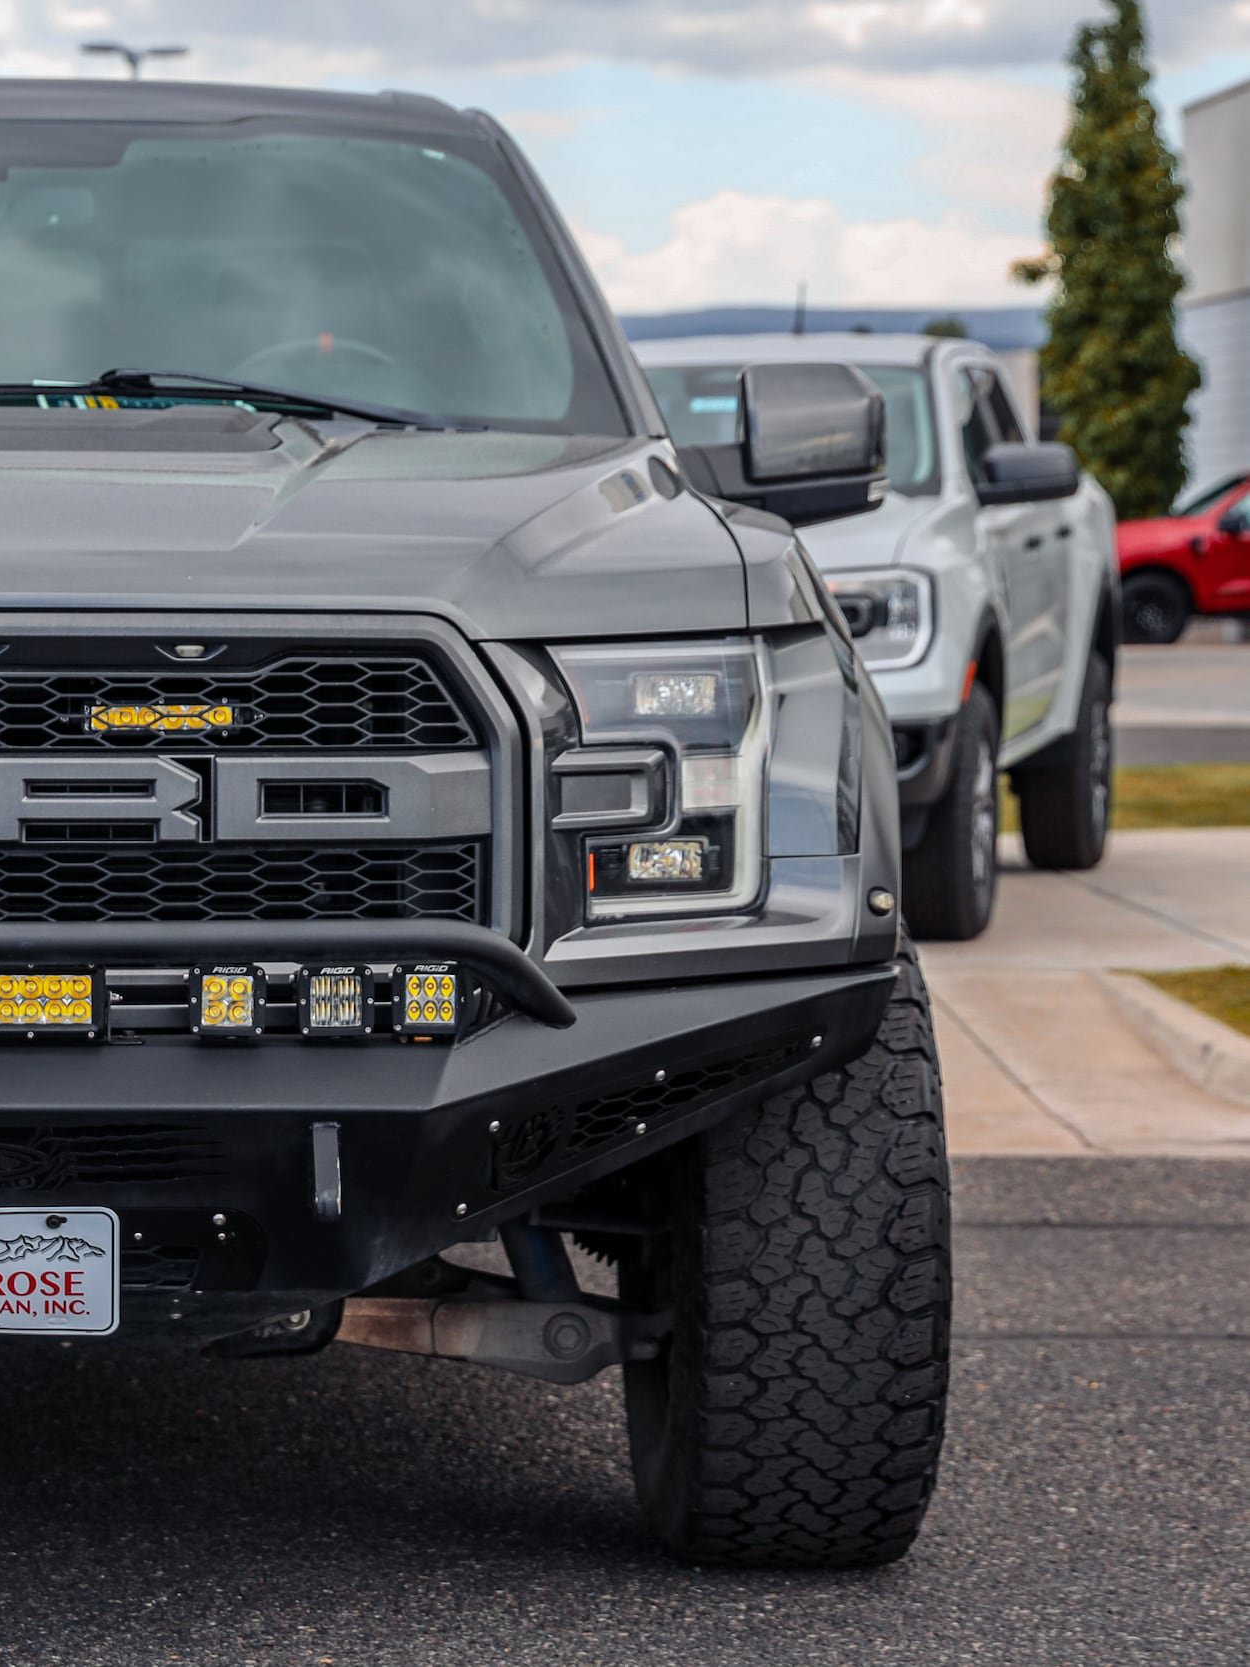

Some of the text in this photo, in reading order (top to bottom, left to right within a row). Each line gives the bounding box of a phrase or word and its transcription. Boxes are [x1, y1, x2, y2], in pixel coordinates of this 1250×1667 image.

[212, 966, 248, 974] RIGID
[320, 966, 355, 975] RIGID
[414, 964, 449, 973] RIGID
[44, 1299, 91, 1316] INC.
